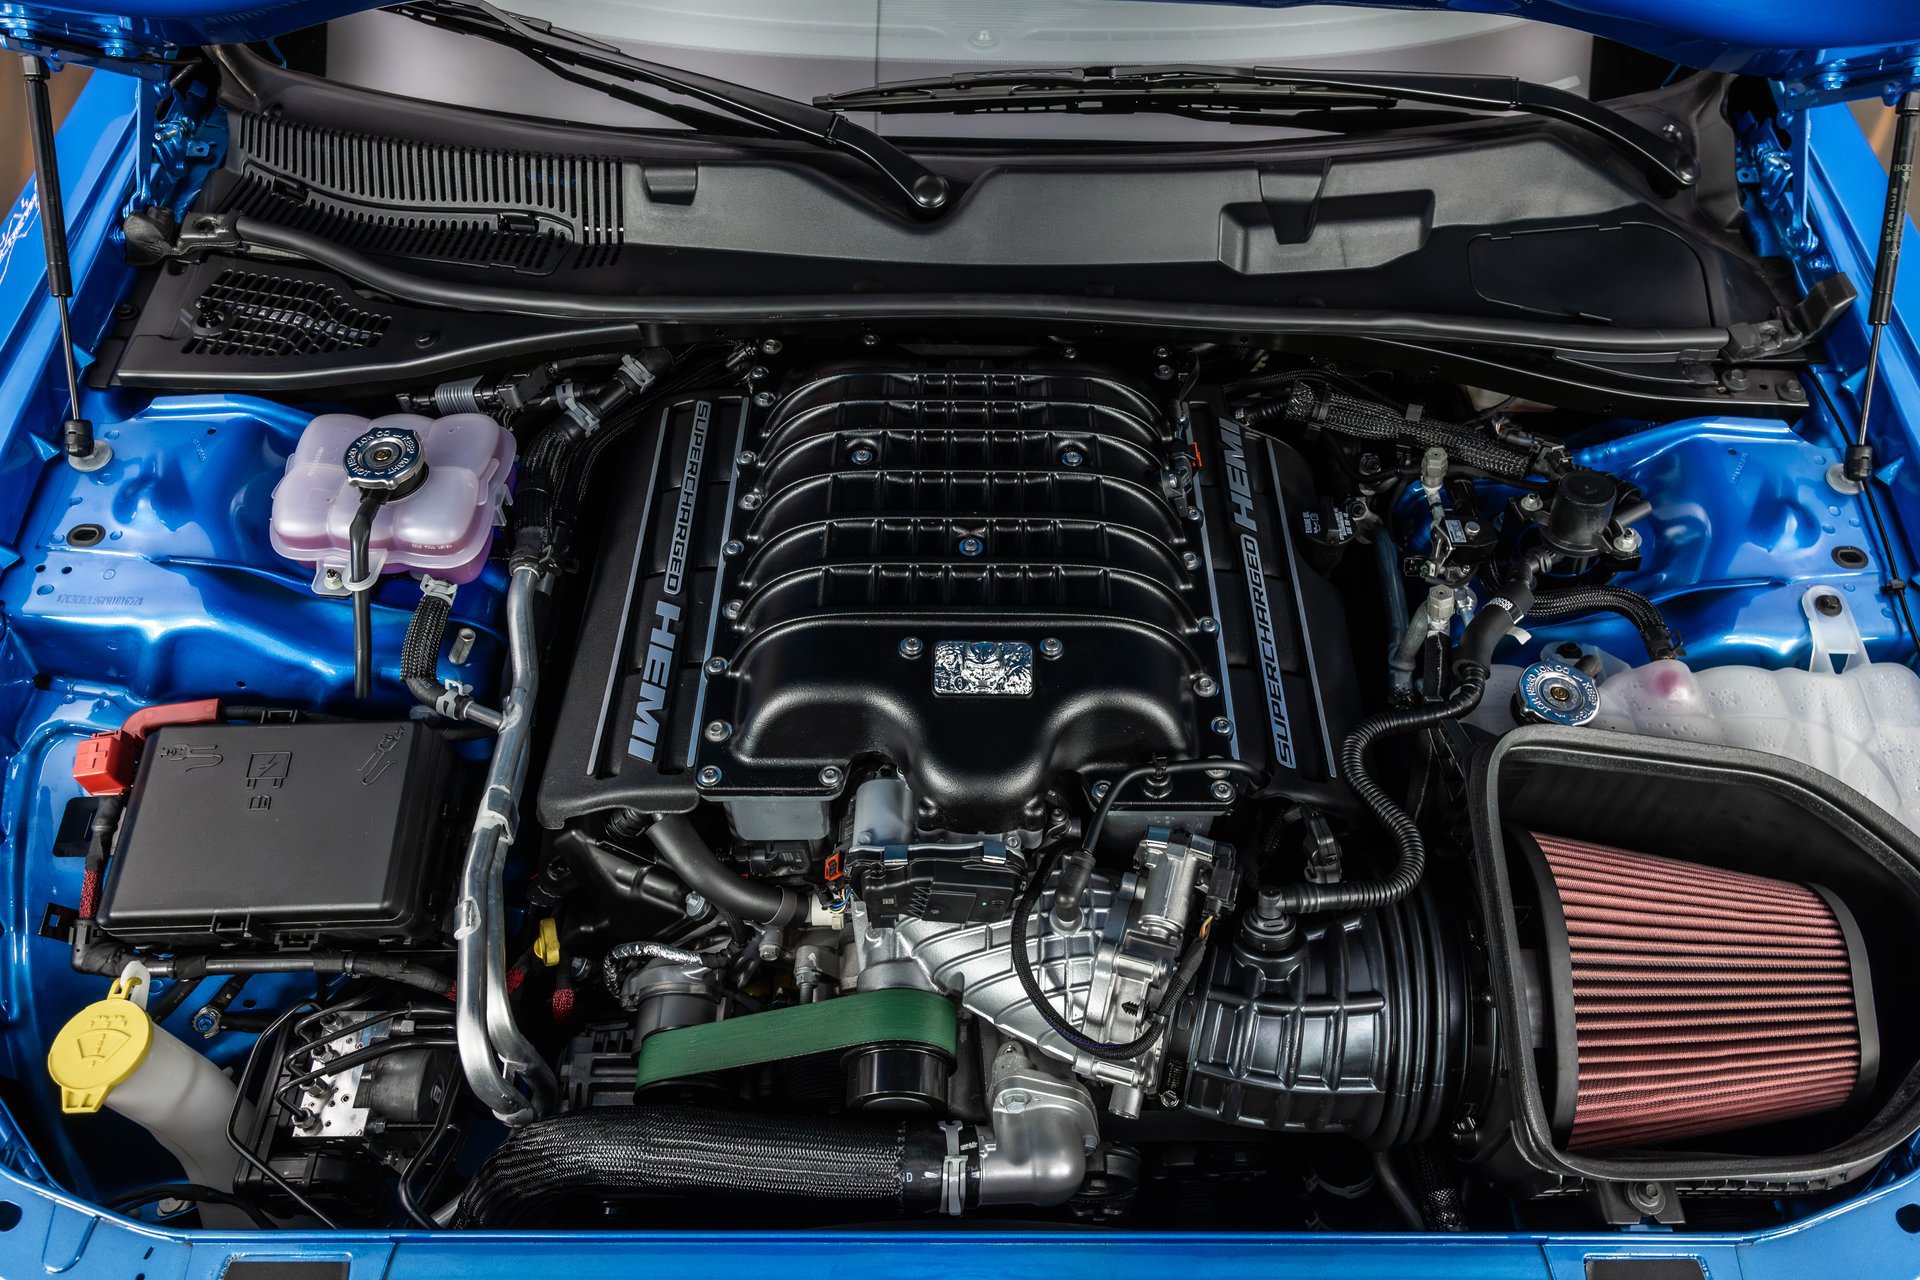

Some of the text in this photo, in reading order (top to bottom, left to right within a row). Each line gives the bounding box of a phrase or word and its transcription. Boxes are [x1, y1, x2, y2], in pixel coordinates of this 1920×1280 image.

[1885, 187, 1898, 242] STABILUS
[347, 430, 390, 477] DO NOT OPEN HOT
[1218, 416, 1258, 533] HEMI
[666, 402, 709, 591] SUPERCHARGED
[1242, 536, 1295, 767] SUPERCHARGED
[1533, 664, 1554, 676] NOT
[1554, 664, 1570, 675] DO
[627, 600, 682, 763] HEMI
[1525, 673, 1537, 696] OPEN
[1531, 696, 1552, 713] HOT
[1582, 682, 1597, 706] KEEP
